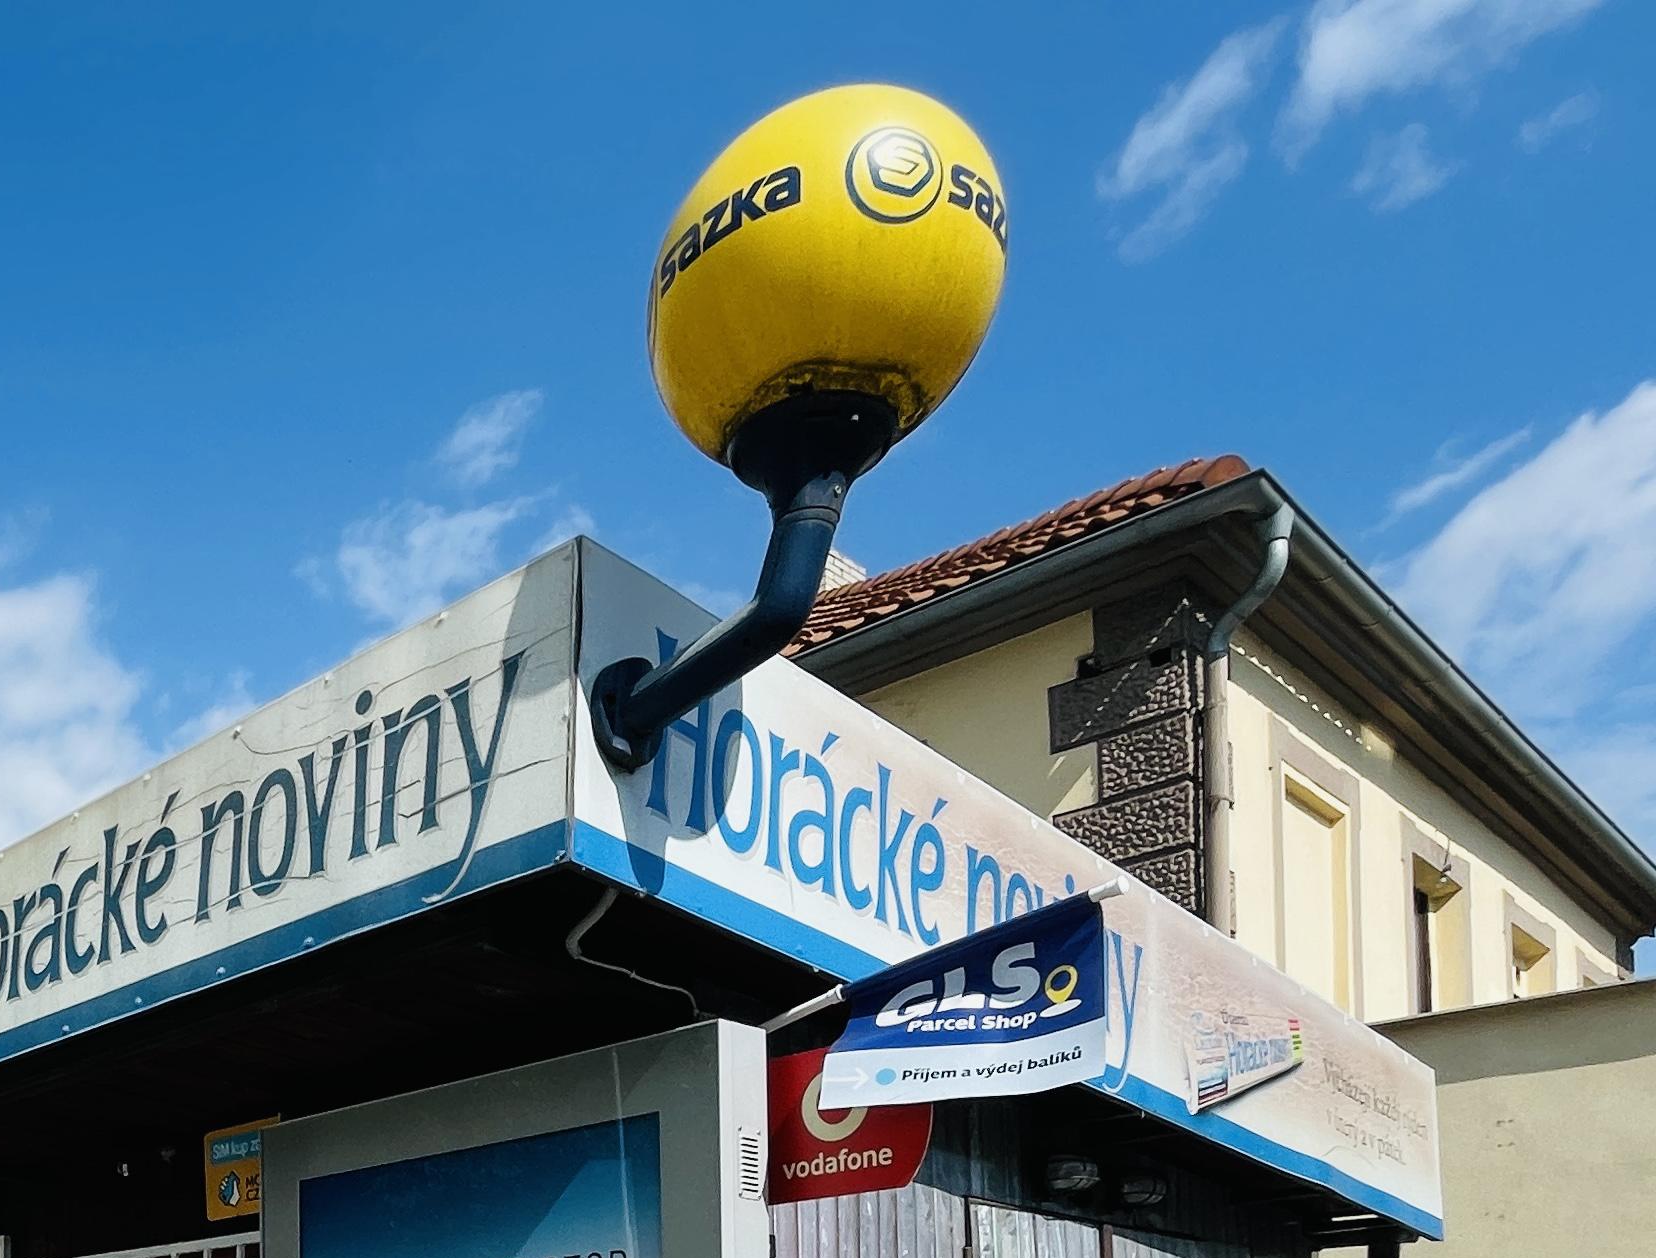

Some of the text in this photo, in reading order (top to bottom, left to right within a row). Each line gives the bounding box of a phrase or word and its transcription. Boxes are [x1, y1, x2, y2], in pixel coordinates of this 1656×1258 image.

[194, 649, 527, 903] noviny
[875, 942, 1041, 1028] GLS
[965, 842, 1144, 1094] noy
[907, 1011, 1037, 1033] Parcel Shop
[901, 1045, 1082, 1083] Příjem a výdej balíků
[782, 1146, 893, 1181] vodafone
